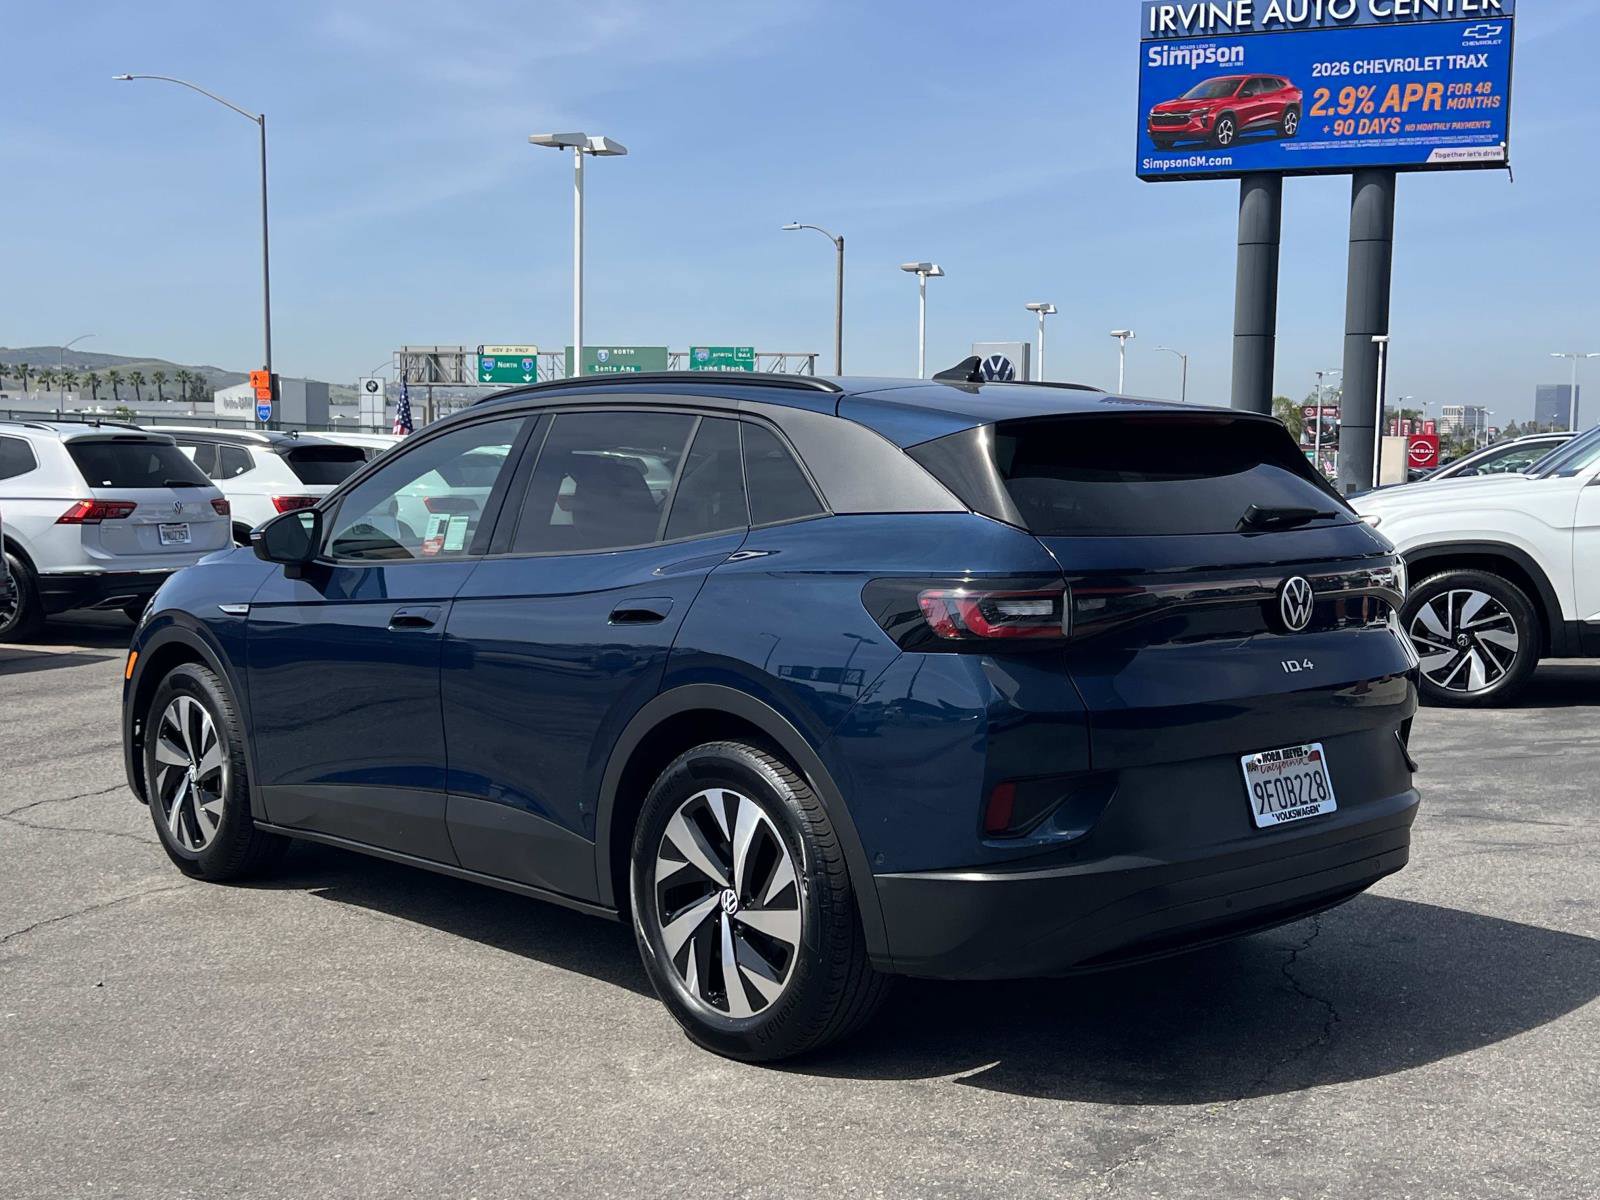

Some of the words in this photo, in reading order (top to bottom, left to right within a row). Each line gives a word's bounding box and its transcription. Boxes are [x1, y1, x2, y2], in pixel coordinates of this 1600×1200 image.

[1150, 0, 1252, 32] IRVINE
[1262, 0, 1357, 25] AUTO
[1461, 39, 1503, 47] CHEVROLET
[1148, 45, 1244, 70] Simpson
[1312, 61, 1350, 78] 2026
[1353, 56, 1444, 75] CHEVROLET
[1446, 53, 1489, 70] TRAX
[1447, 83, 1473, 96] FOR
[1475, 82, 1492, 94] 48
[1310, 84, 1377, 117] 2.9%
[1379, 82, 1444, 114] APR
[1446, 96, 1501, 110] MONTHS
[1333, 119, 1355, 137] 90
[1357, 117, 1402, 135] DAYS
[1405, 123, 1415, 132] NO
[1416, 121, 1450, 131] MONTHLY
[1451, 120, 1491, 130] PAYMENTS
[1434, 151, 1466, 159] Together
[1467, 150, 1482, 158] let's
[1142, 156, 1233, 171] SimpsonGM.com
[1261, 750, 1281, 764] NORM
